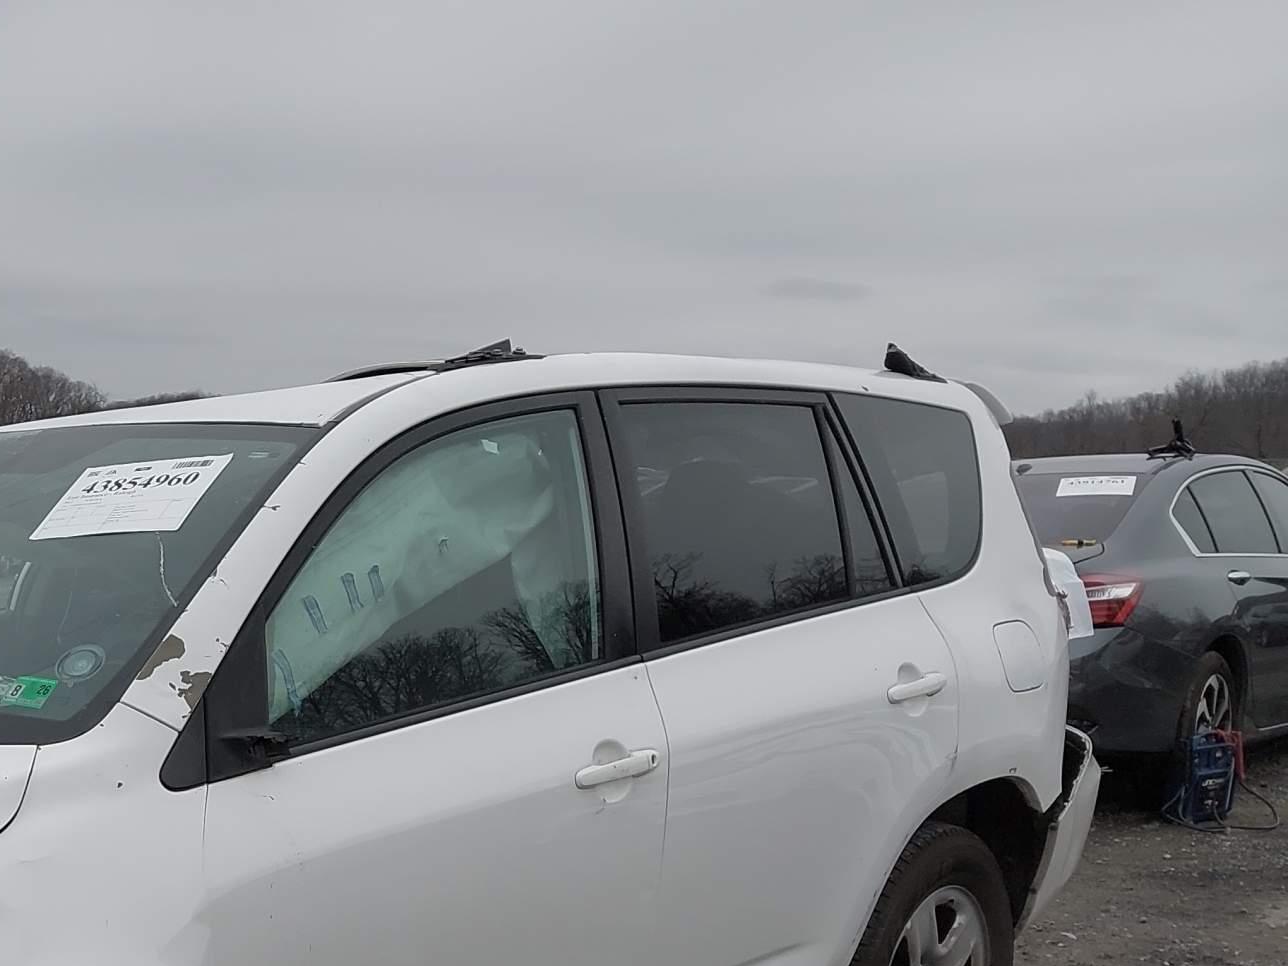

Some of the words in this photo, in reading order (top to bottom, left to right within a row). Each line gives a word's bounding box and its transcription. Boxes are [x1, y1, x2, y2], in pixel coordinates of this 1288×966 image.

[81, 471, 200, 494] 43854960
[10, 684, 22, 697] 8
[37, 684, 52, 696] 26
